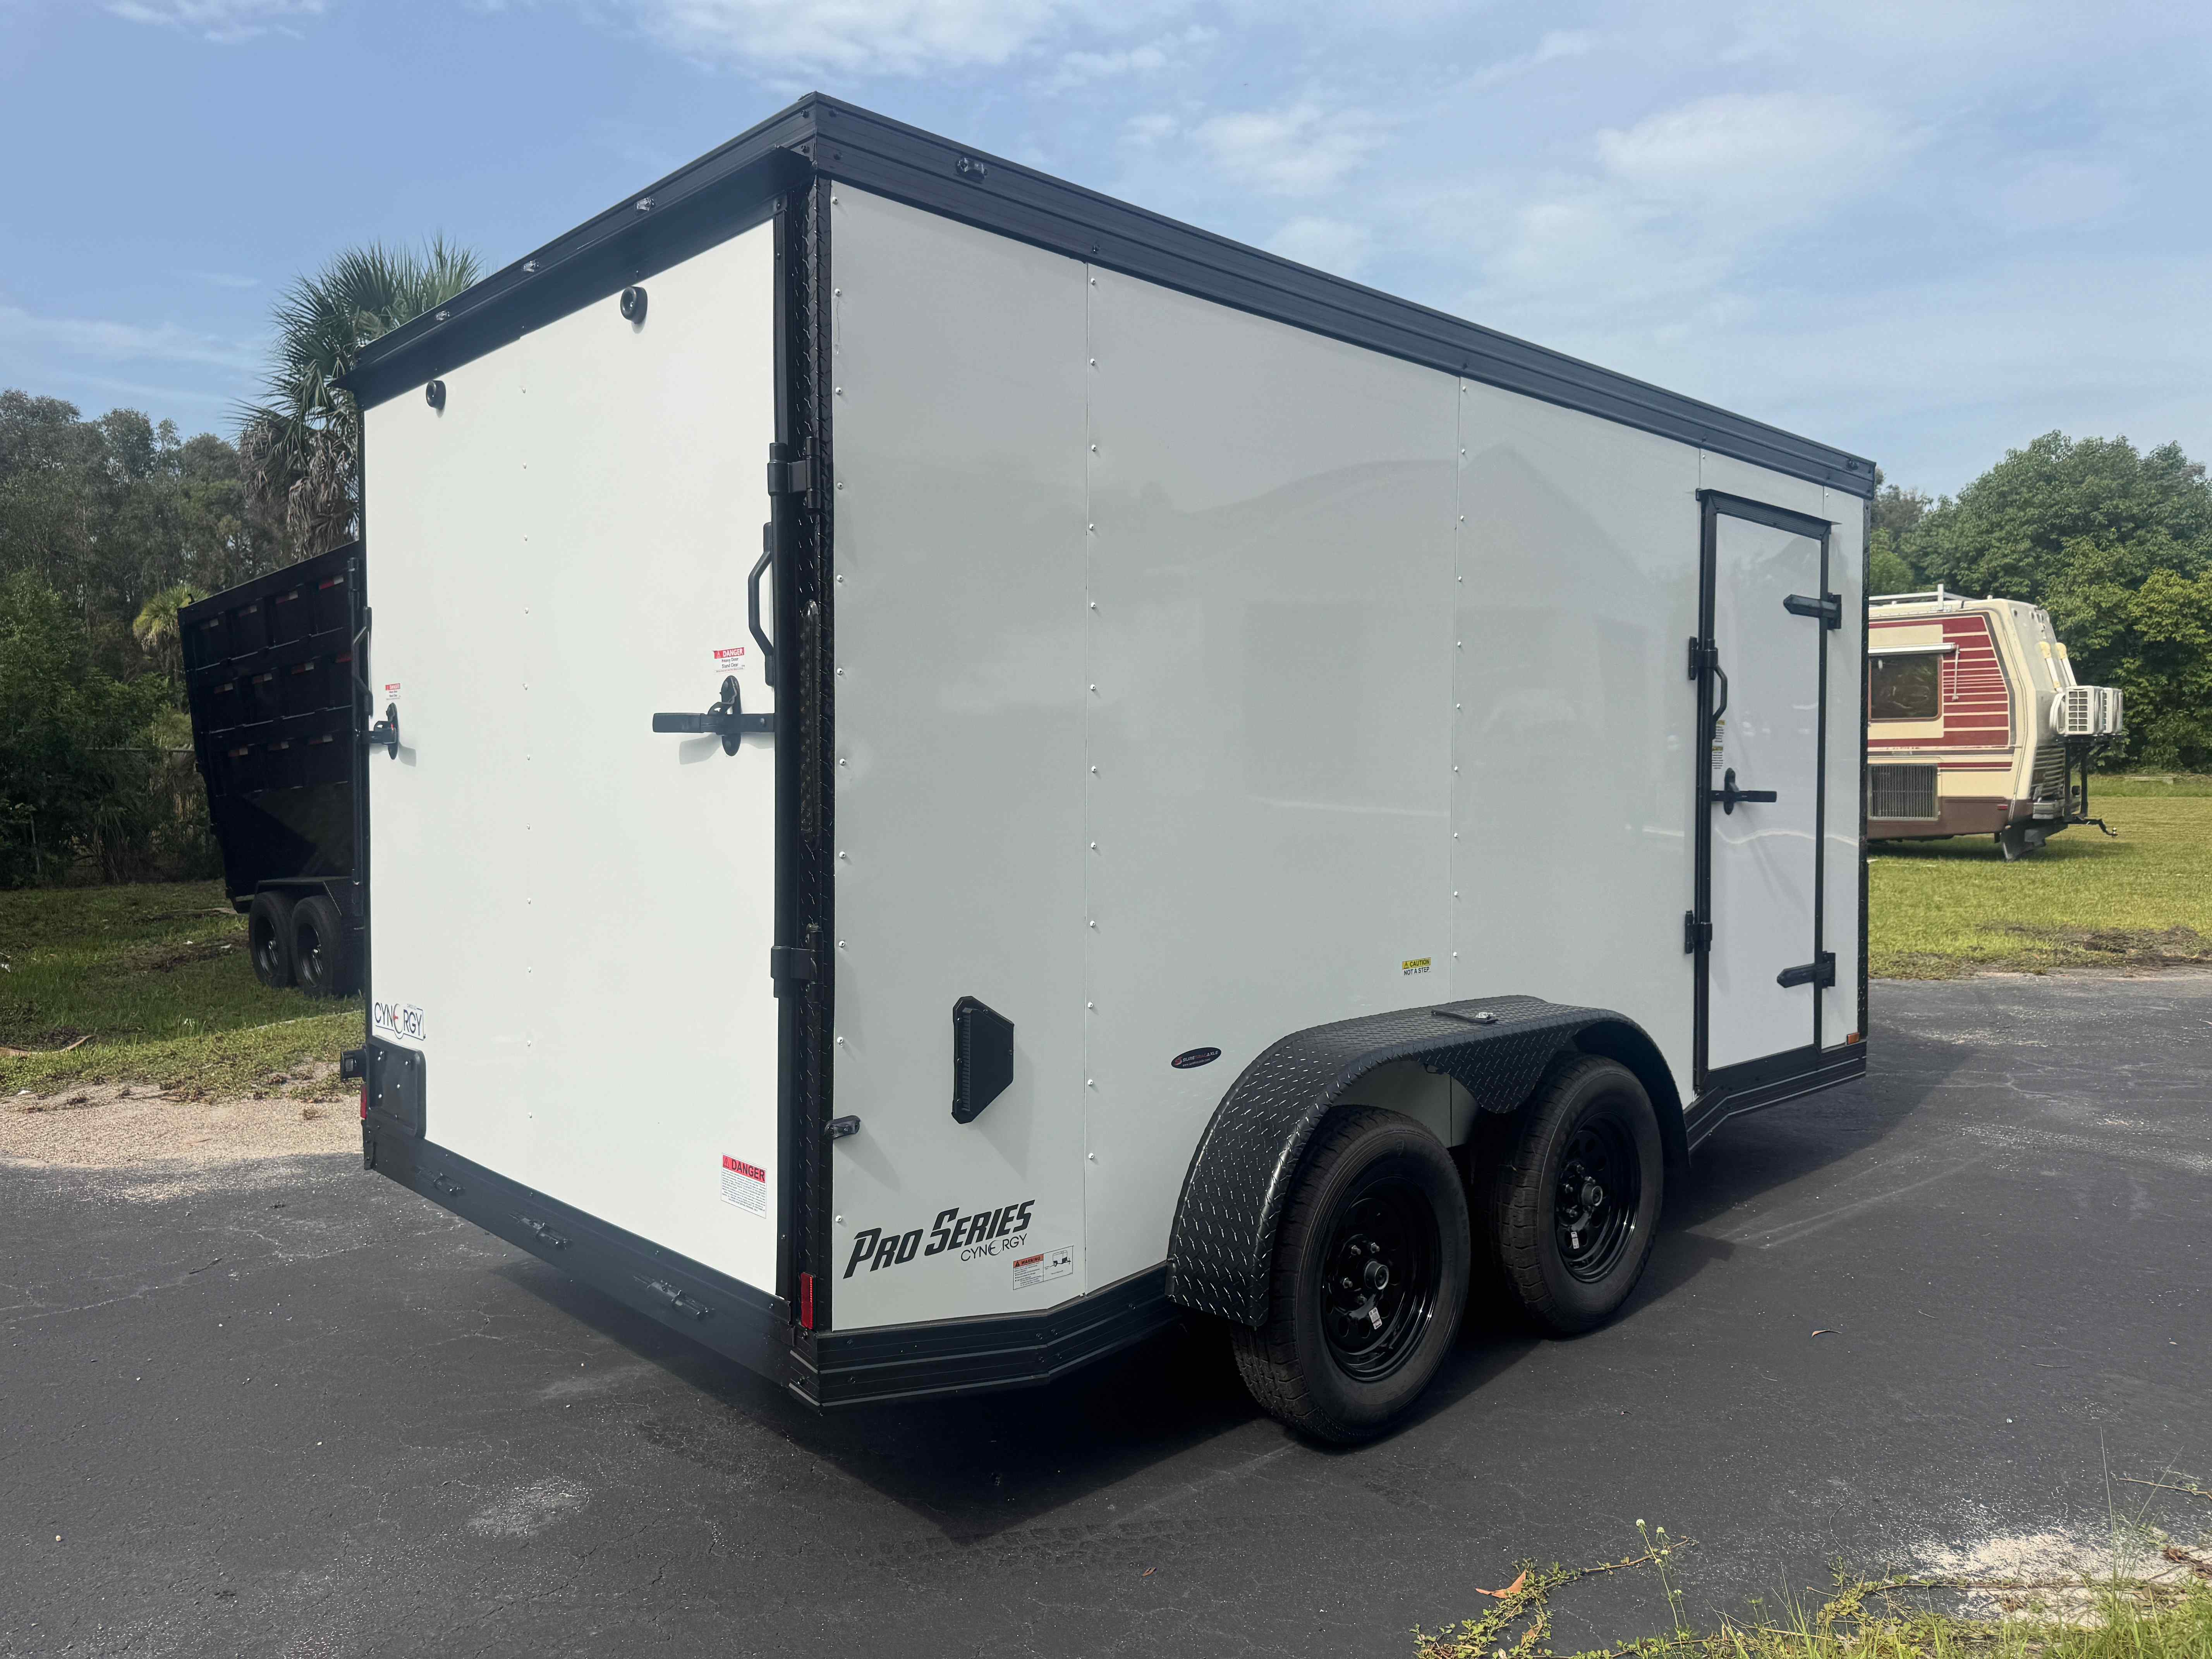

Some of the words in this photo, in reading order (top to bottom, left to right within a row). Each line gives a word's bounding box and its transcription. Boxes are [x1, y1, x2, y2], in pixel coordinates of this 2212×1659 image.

[723, 649, 743, 657] DANGER
[1410, 959, 1429, 967] CAUTION
[732, 1159, 765, 1181] DANGER
[843, 1227, 924, 1279] PRO
[924, 1199, 1035, 1256] SERIES
[961, 1233, 1027, 1262] CYNERGY
[1022, 1256, 1041, 1265] WARNING
